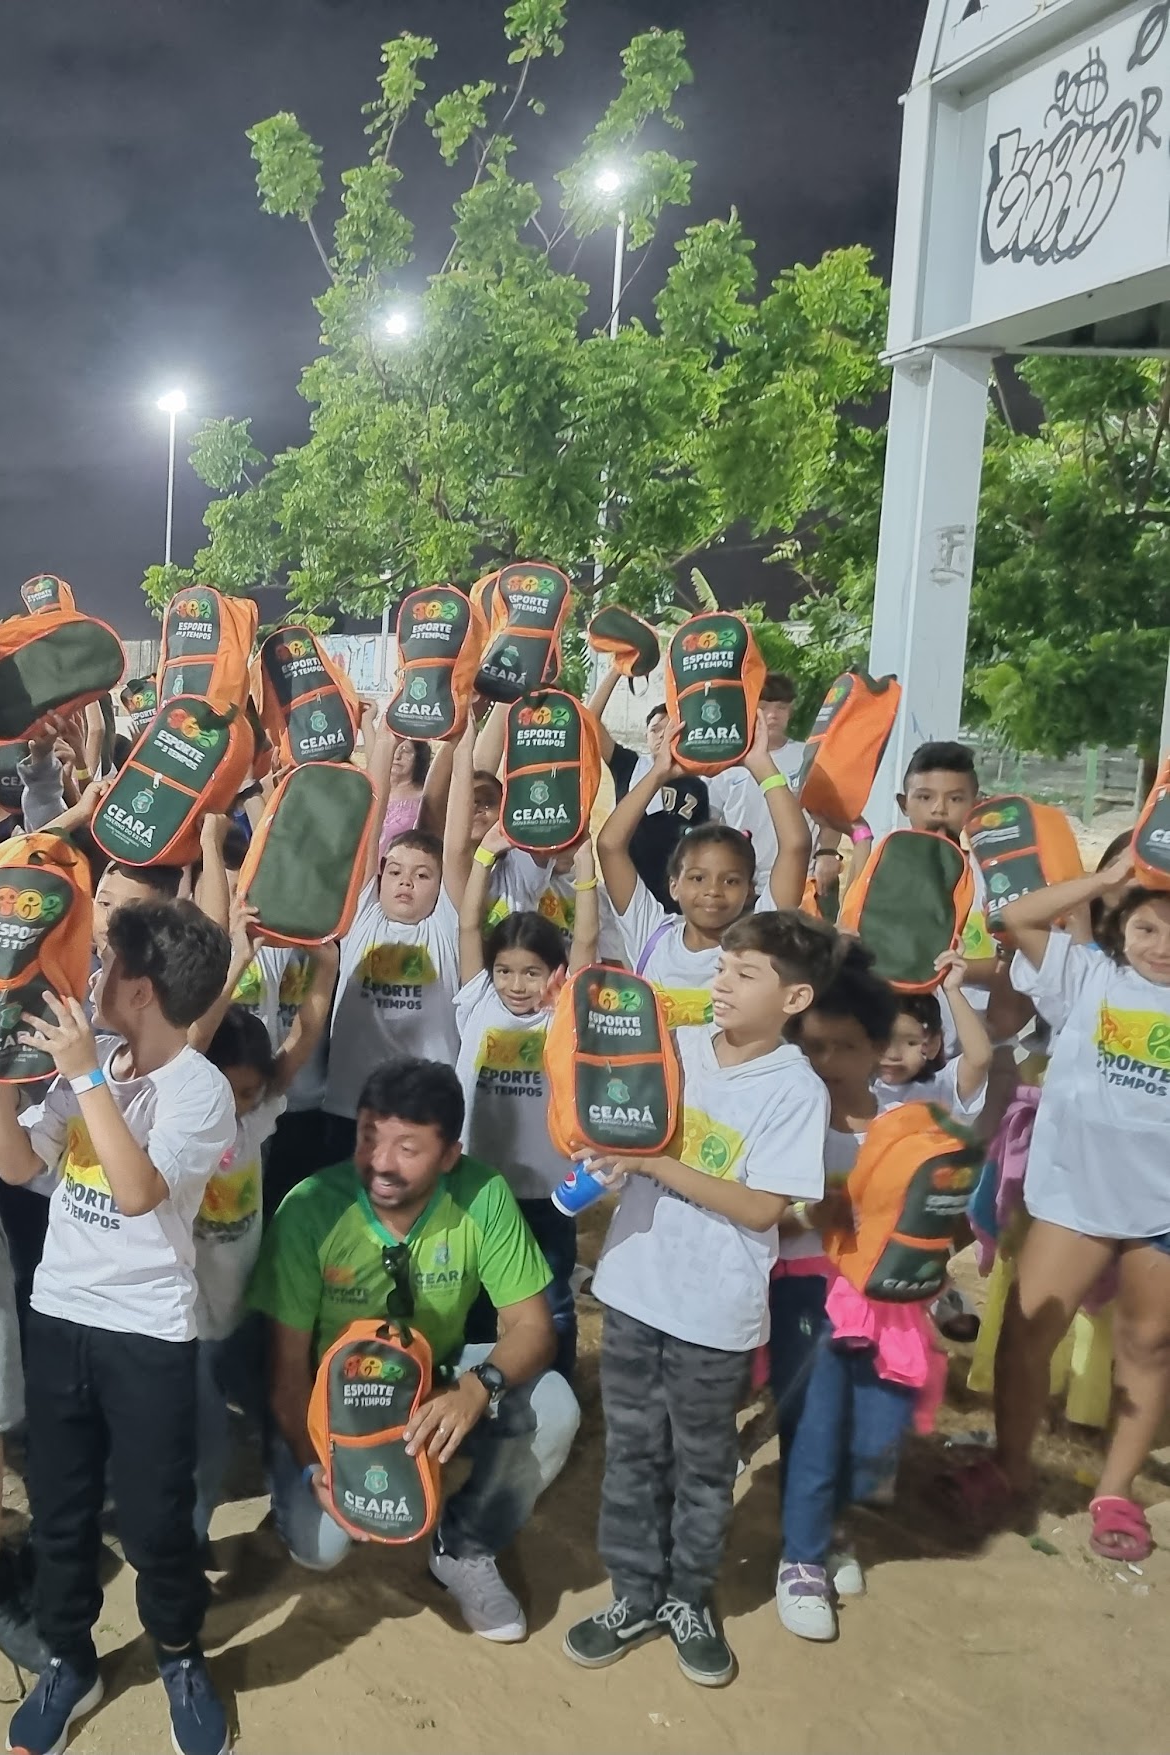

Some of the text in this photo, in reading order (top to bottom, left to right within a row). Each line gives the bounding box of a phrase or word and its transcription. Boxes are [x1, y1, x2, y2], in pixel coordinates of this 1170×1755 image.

[508, 594, 550, 608] ESPORTE
[178, 622, 213, 633] ESPORTE
[412, 623, 453, 634] ESPORTE
[187, 631, 212, 641] TEMPOS
[420, 633, 450, 641] TEMPOS
[682, 651, 734, 666] ESPORTE
[691, 662, 698, 671] 3
[698, 659, 734, 670] TEMPOS
[481, 663, 528, 687] CEARÁ
[299, 728, 346, 750] CEARÁ
[517, 729, 567, 741] ESPORTE
[687, 723, 741, 741] CEARÁ
[157, 730, 206, 763] ESPORTE
[525, 739, 531, 747] 3
[532, 738, 566, 748] TEMPOS
[167, 747, 199, 771] TEMPOS
[512, 803, 568, 821] CEARÁ
[107, 804, 156, 843] CEARÁ
[1, 938, 10, 948] 3
[375, 998, 422, 1011] TEMPOS
[588, 1010, 641, 1028] ESPORTE
[601, 1026, 642, 1037] TEMPOS
[494, 1084, 543, 1097] TEMPOS
[1109, 1072, 1167, 1097] TEMPOS
[588, 1104, 654, 1124] CEARÁ
[70, 1203, 120, 1230] TEMPOS
[343, 1384, 394, 1398] ESPORTE
[360, 1397, 392, 1407] TEMPOS
[344, 1490, 410, 1516] CEARÁ
[385, 1513, 413, 1523] ESTADO
